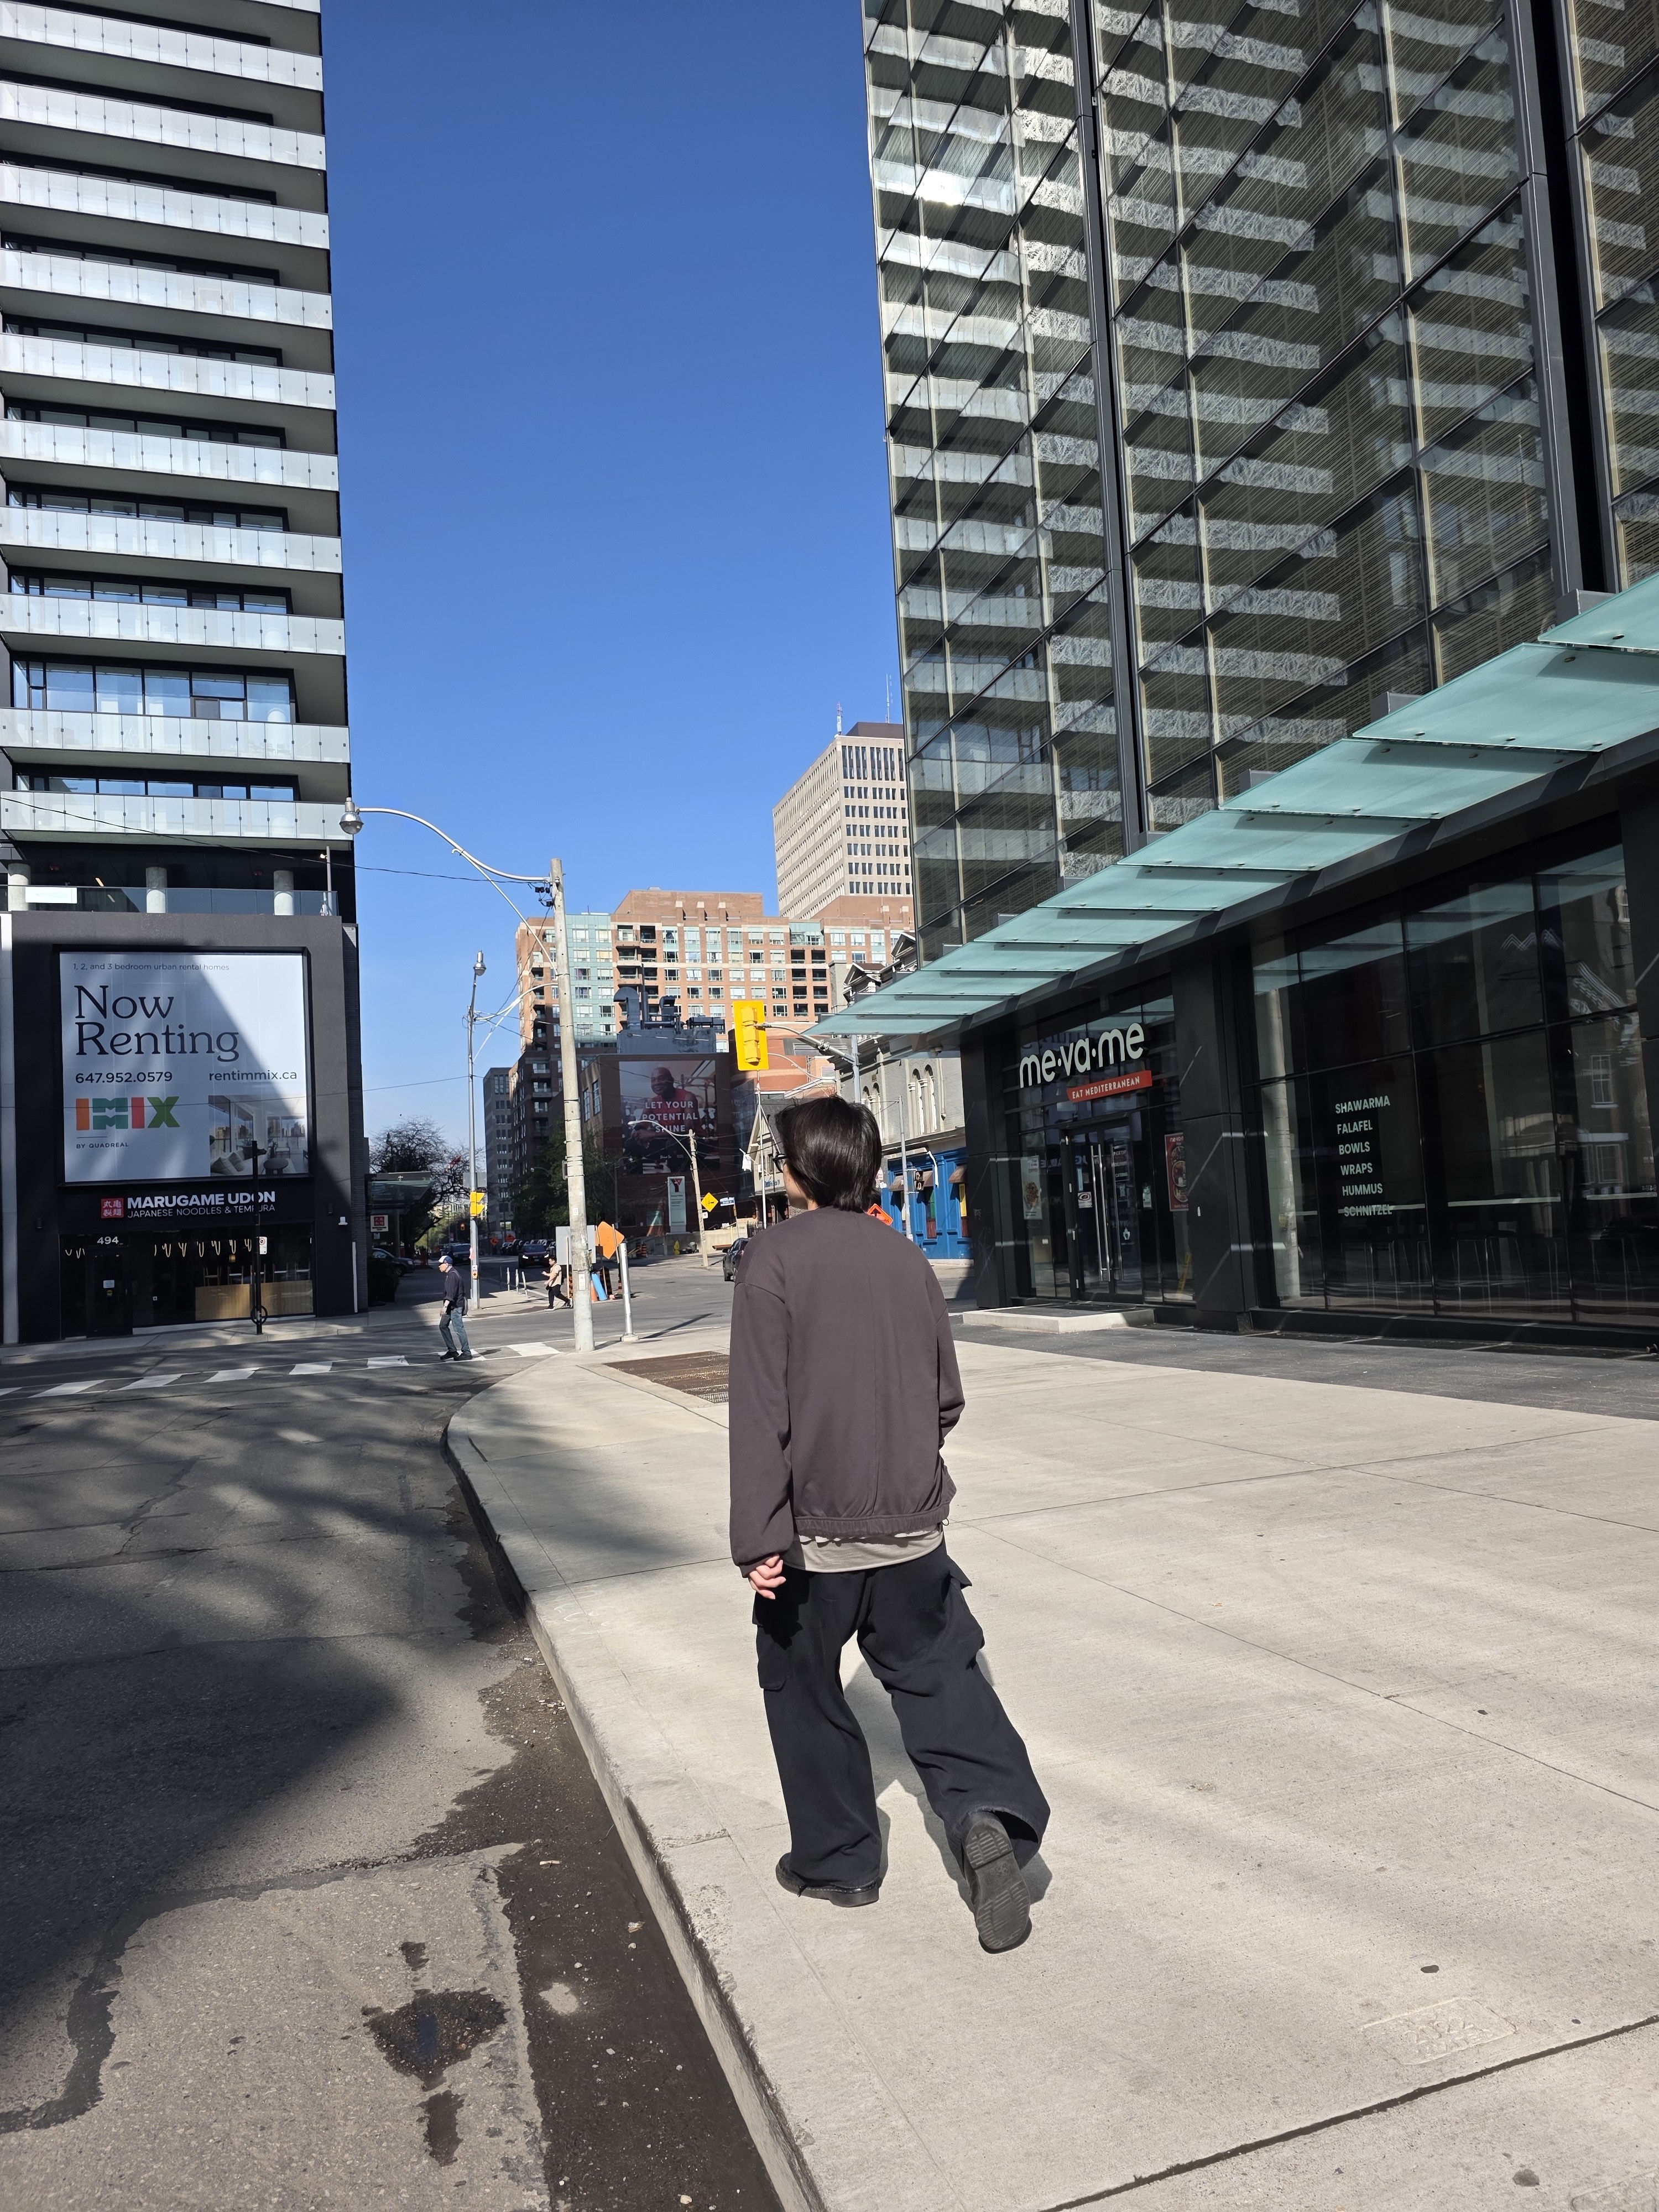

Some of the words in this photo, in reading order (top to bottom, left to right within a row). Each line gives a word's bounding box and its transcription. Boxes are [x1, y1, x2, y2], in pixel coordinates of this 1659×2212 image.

[74, 985, 174, 1019] Now
[75, 1021, 239, 1062] Renting
[75, 1071, 173, 1083] 647.952.0579
[209, 1070, 298, 1081] rentimmix.ca
[1072, 1089, 1083, 1099] EAT
[1085, 1076, 1140, 1096] MEDITERRANEAN
[1335, 1095, 1391, 1114] SHAWARMA
[642, 1112, 698, 1120] POTENTIAL
[1337, 1119, 1373, 1134] FALAFEL
[1338, 1141, 1370, 1155] BOWLS
[1340, 1162, 1373, 1175] WRAPS
[1342, 1183, 1383, 1196] HUMMUS
[127, 1193, 225, 1209] MARUGAME
[127, 1209, 173, 1218] JAPANESE
[176, 1207, 222, 1216] NOODLES
[1344, 1204, 1392, 1217] SCHNITZEL
[97, 1236, 119, 1244] 494
